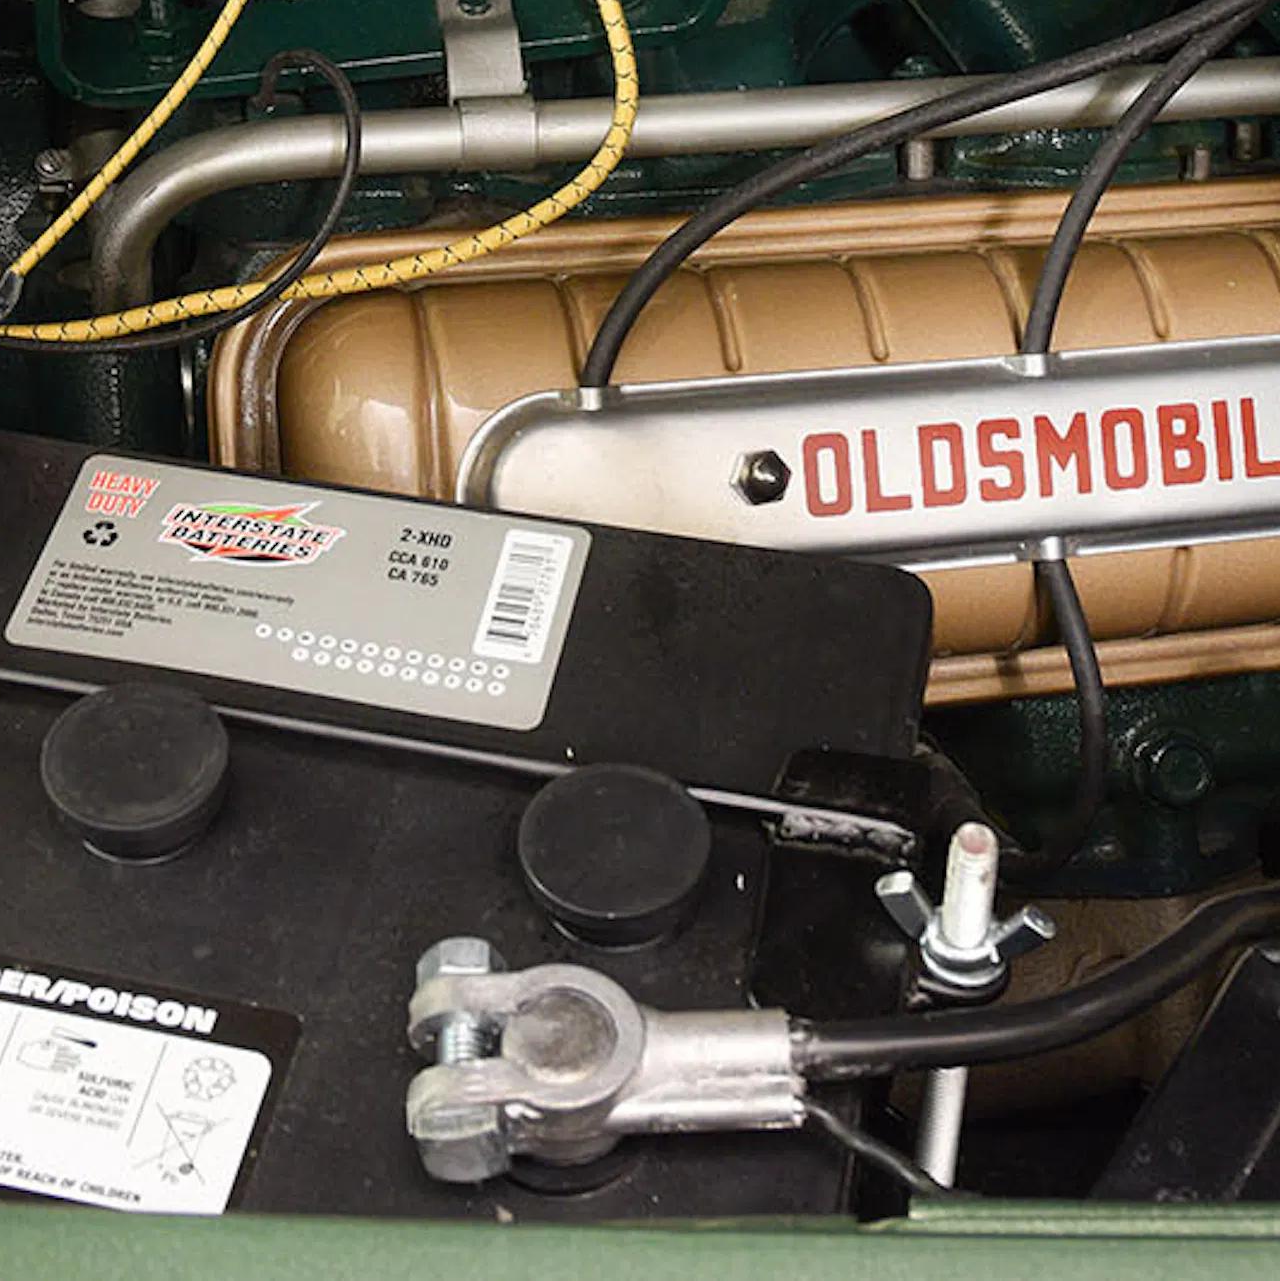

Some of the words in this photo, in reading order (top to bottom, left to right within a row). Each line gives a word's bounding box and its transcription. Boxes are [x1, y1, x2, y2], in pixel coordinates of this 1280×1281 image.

[90, 470, 160, 498] HEAVY
[85, 491, 147, 518] DUTY
[173, 509, 331, 545] INTERSTATE
[400, 528, 452, 549] 2-XHD
[171, 527, 313, 557] BATTERIES
[389, 550, 417, 566] CCA
[421, 556, 449, 571] 610
[388, 567, 407, 581] CA
[411, 570, 439, 587] 765
[16, 1168, 59, 1185] REACH
[60, 1177, 78, 1189] OF
